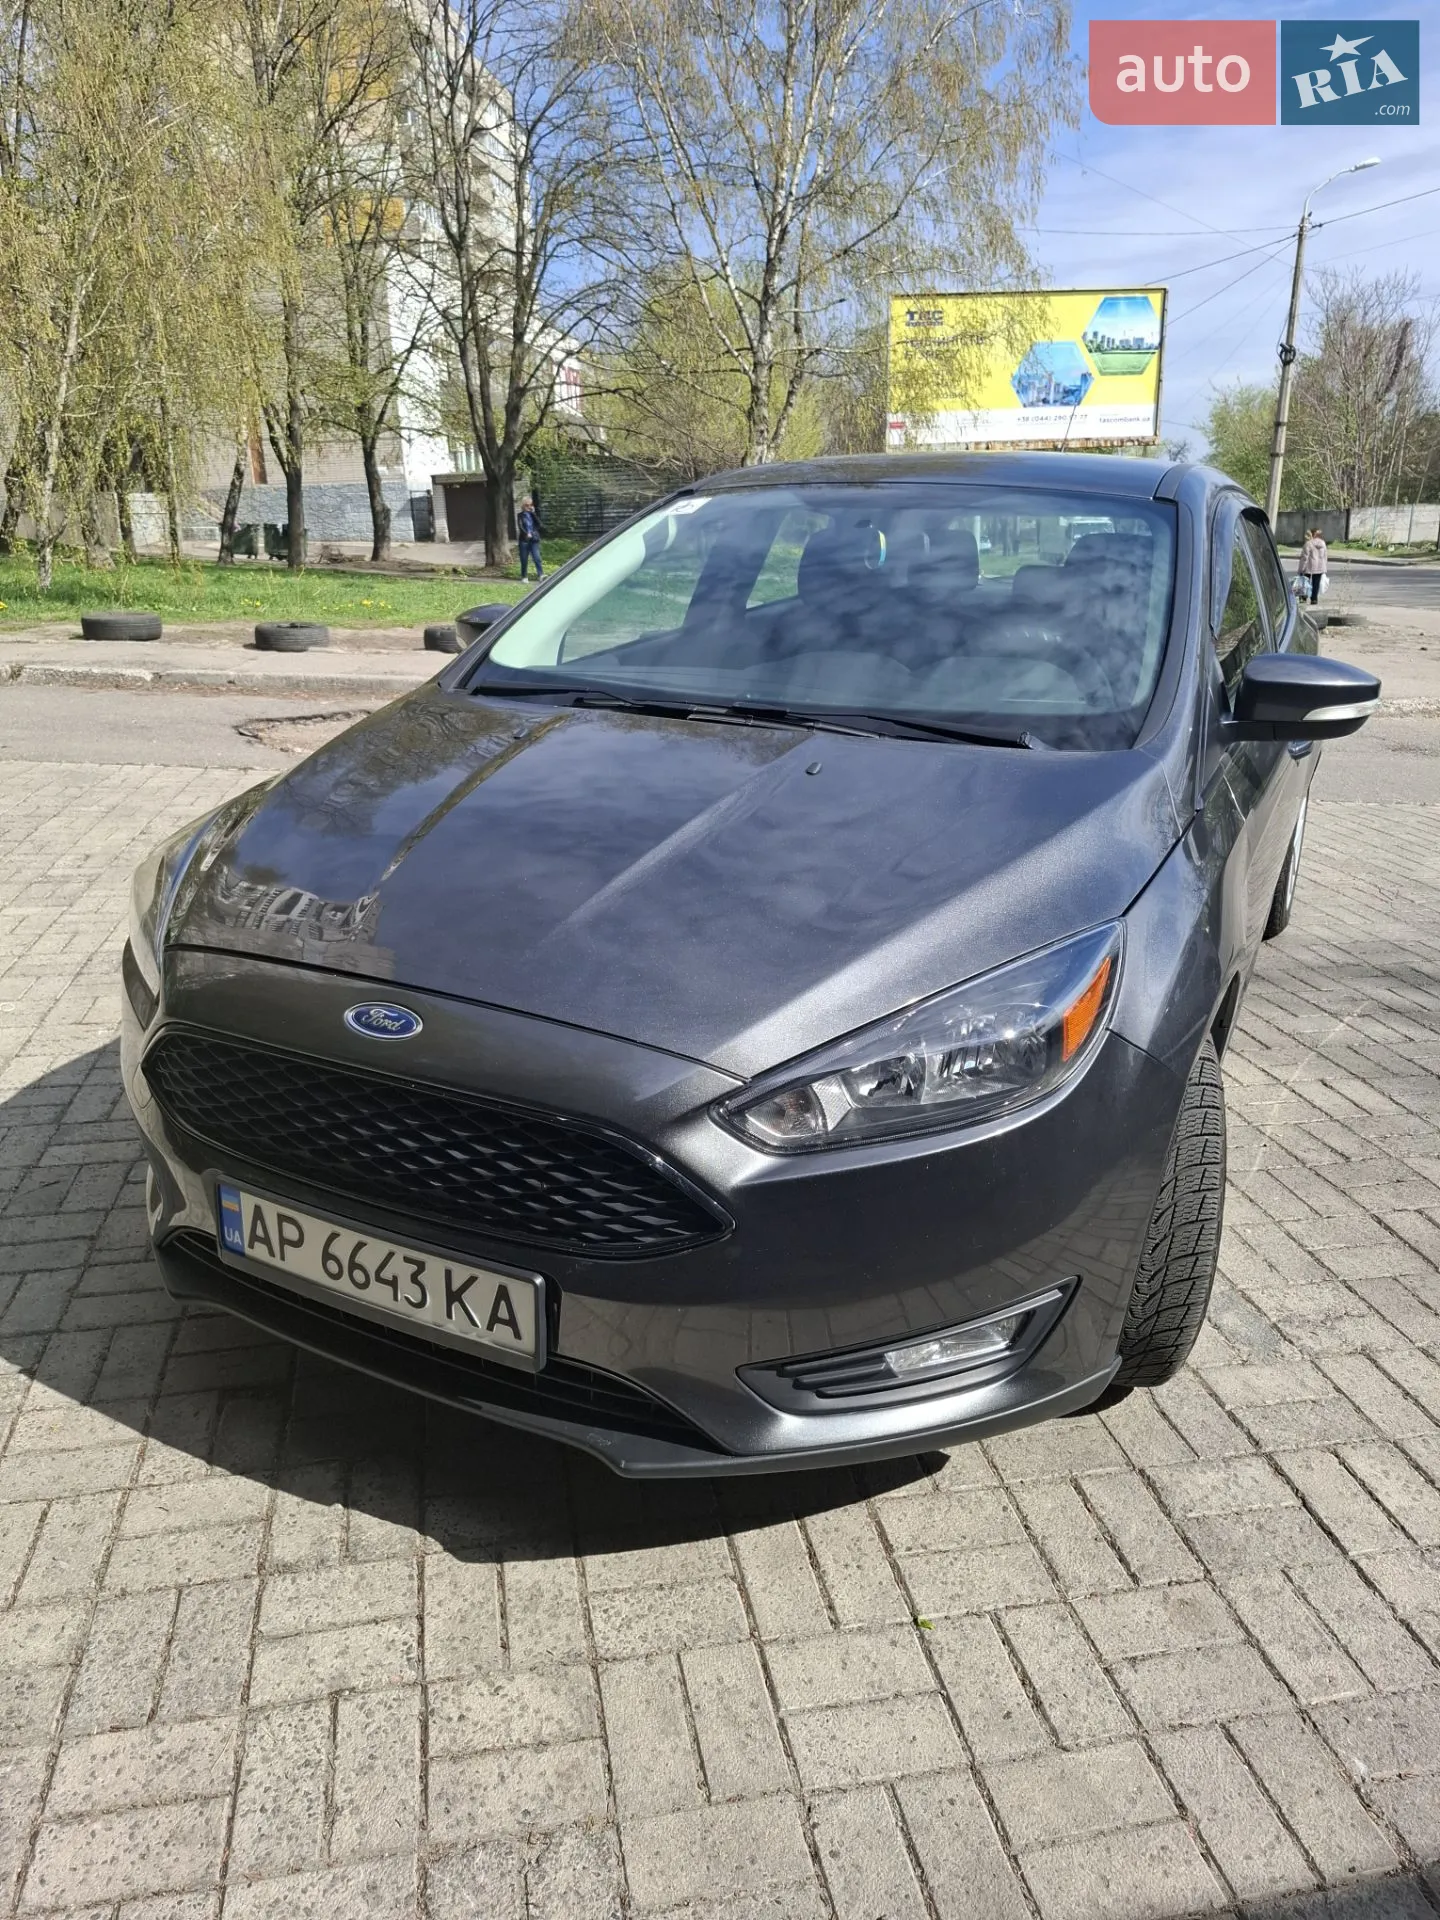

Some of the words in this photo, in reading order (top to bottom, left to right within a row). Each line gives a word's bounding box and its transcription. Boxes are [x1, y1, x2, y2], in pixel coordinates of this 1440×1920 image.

[362, 1008, 406, 1031] Ford
[225, 1226, 243, 1246] UA
[247, 1204, 305, 1262] AP
[321, 1232, 429, 1309] 6643
[444, 1268, 522, 1341] KA
